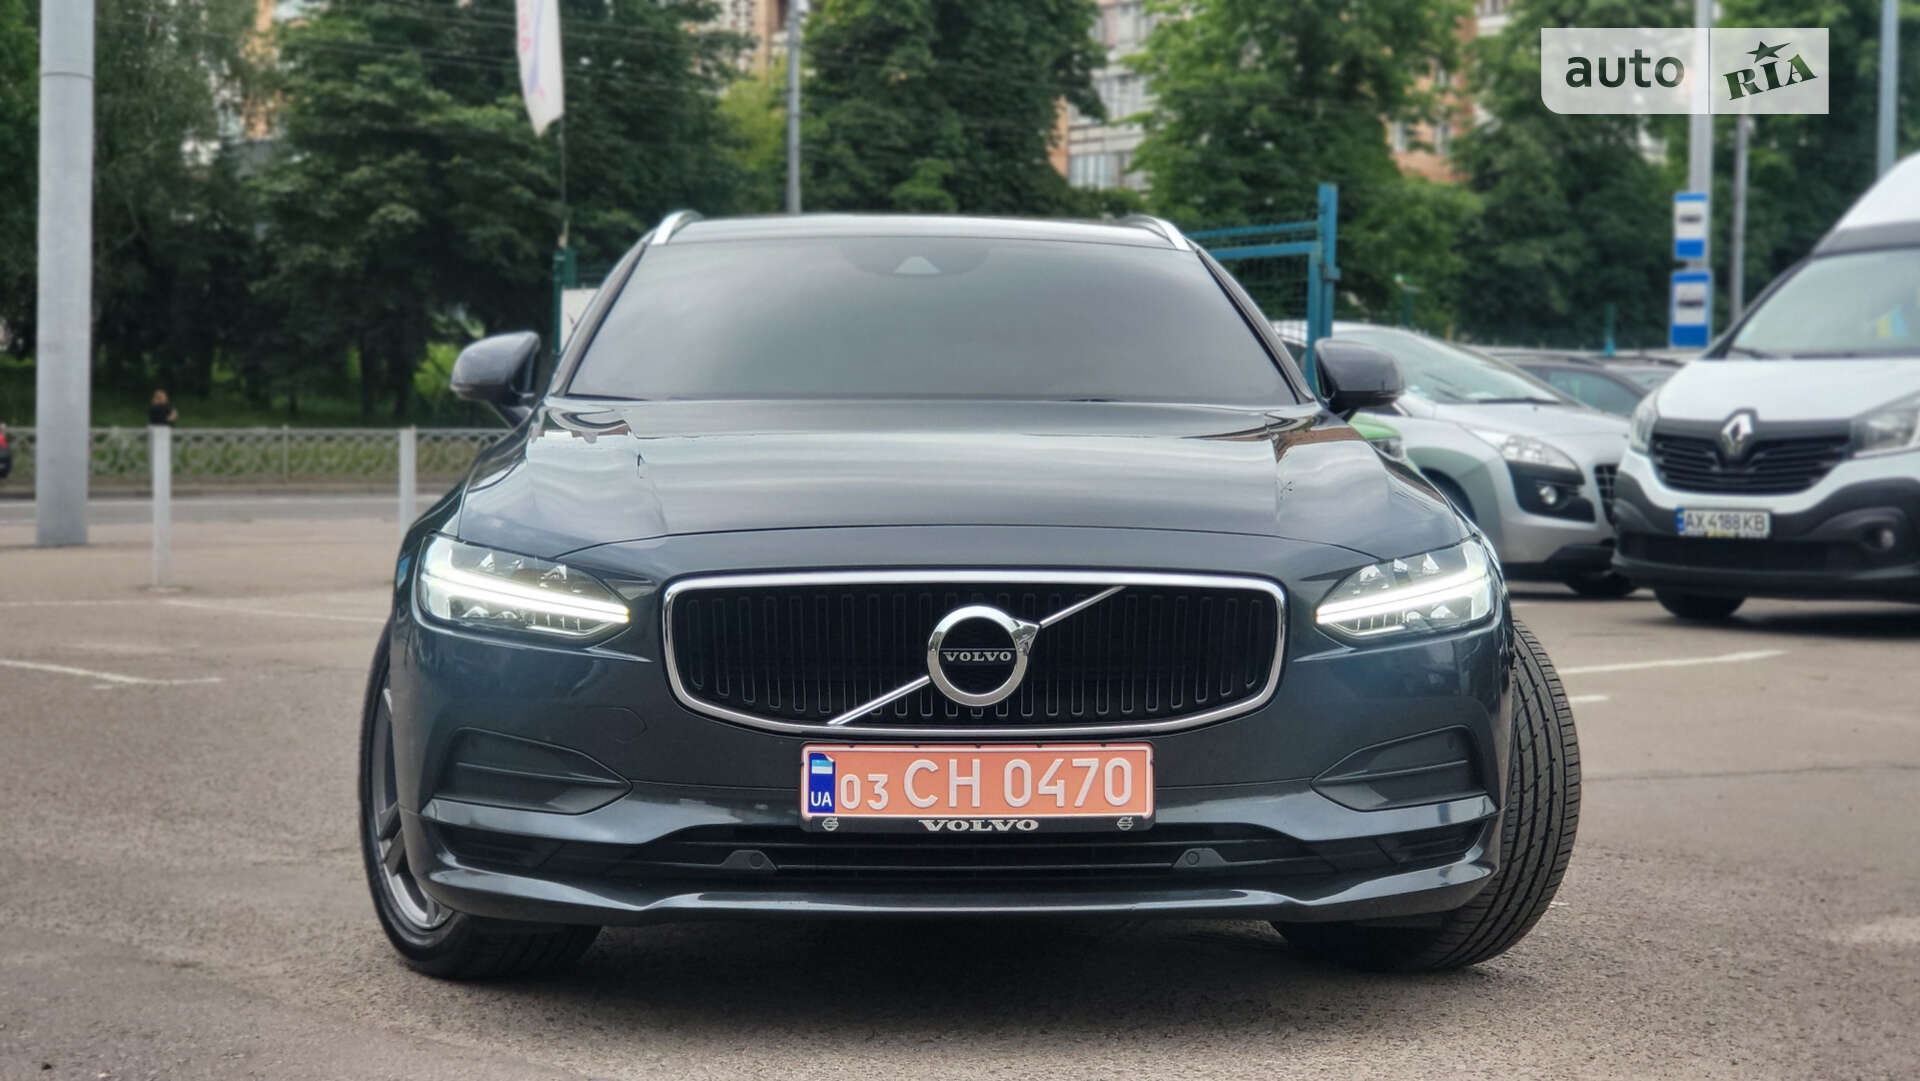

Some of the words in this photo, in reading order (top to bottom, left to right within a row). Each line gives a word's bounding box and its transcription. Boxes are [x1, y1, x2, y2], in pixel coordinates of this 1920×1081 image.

[943, 651, 1012, 662] VOLVO
[840, 773, 889, 810] 03
[903, 758, 981, 808] CH
[1003, 757, 1133, 808] 0470
[810, 790, 833, 807] UA
[918, 819, 1040, 832] VOLVO
